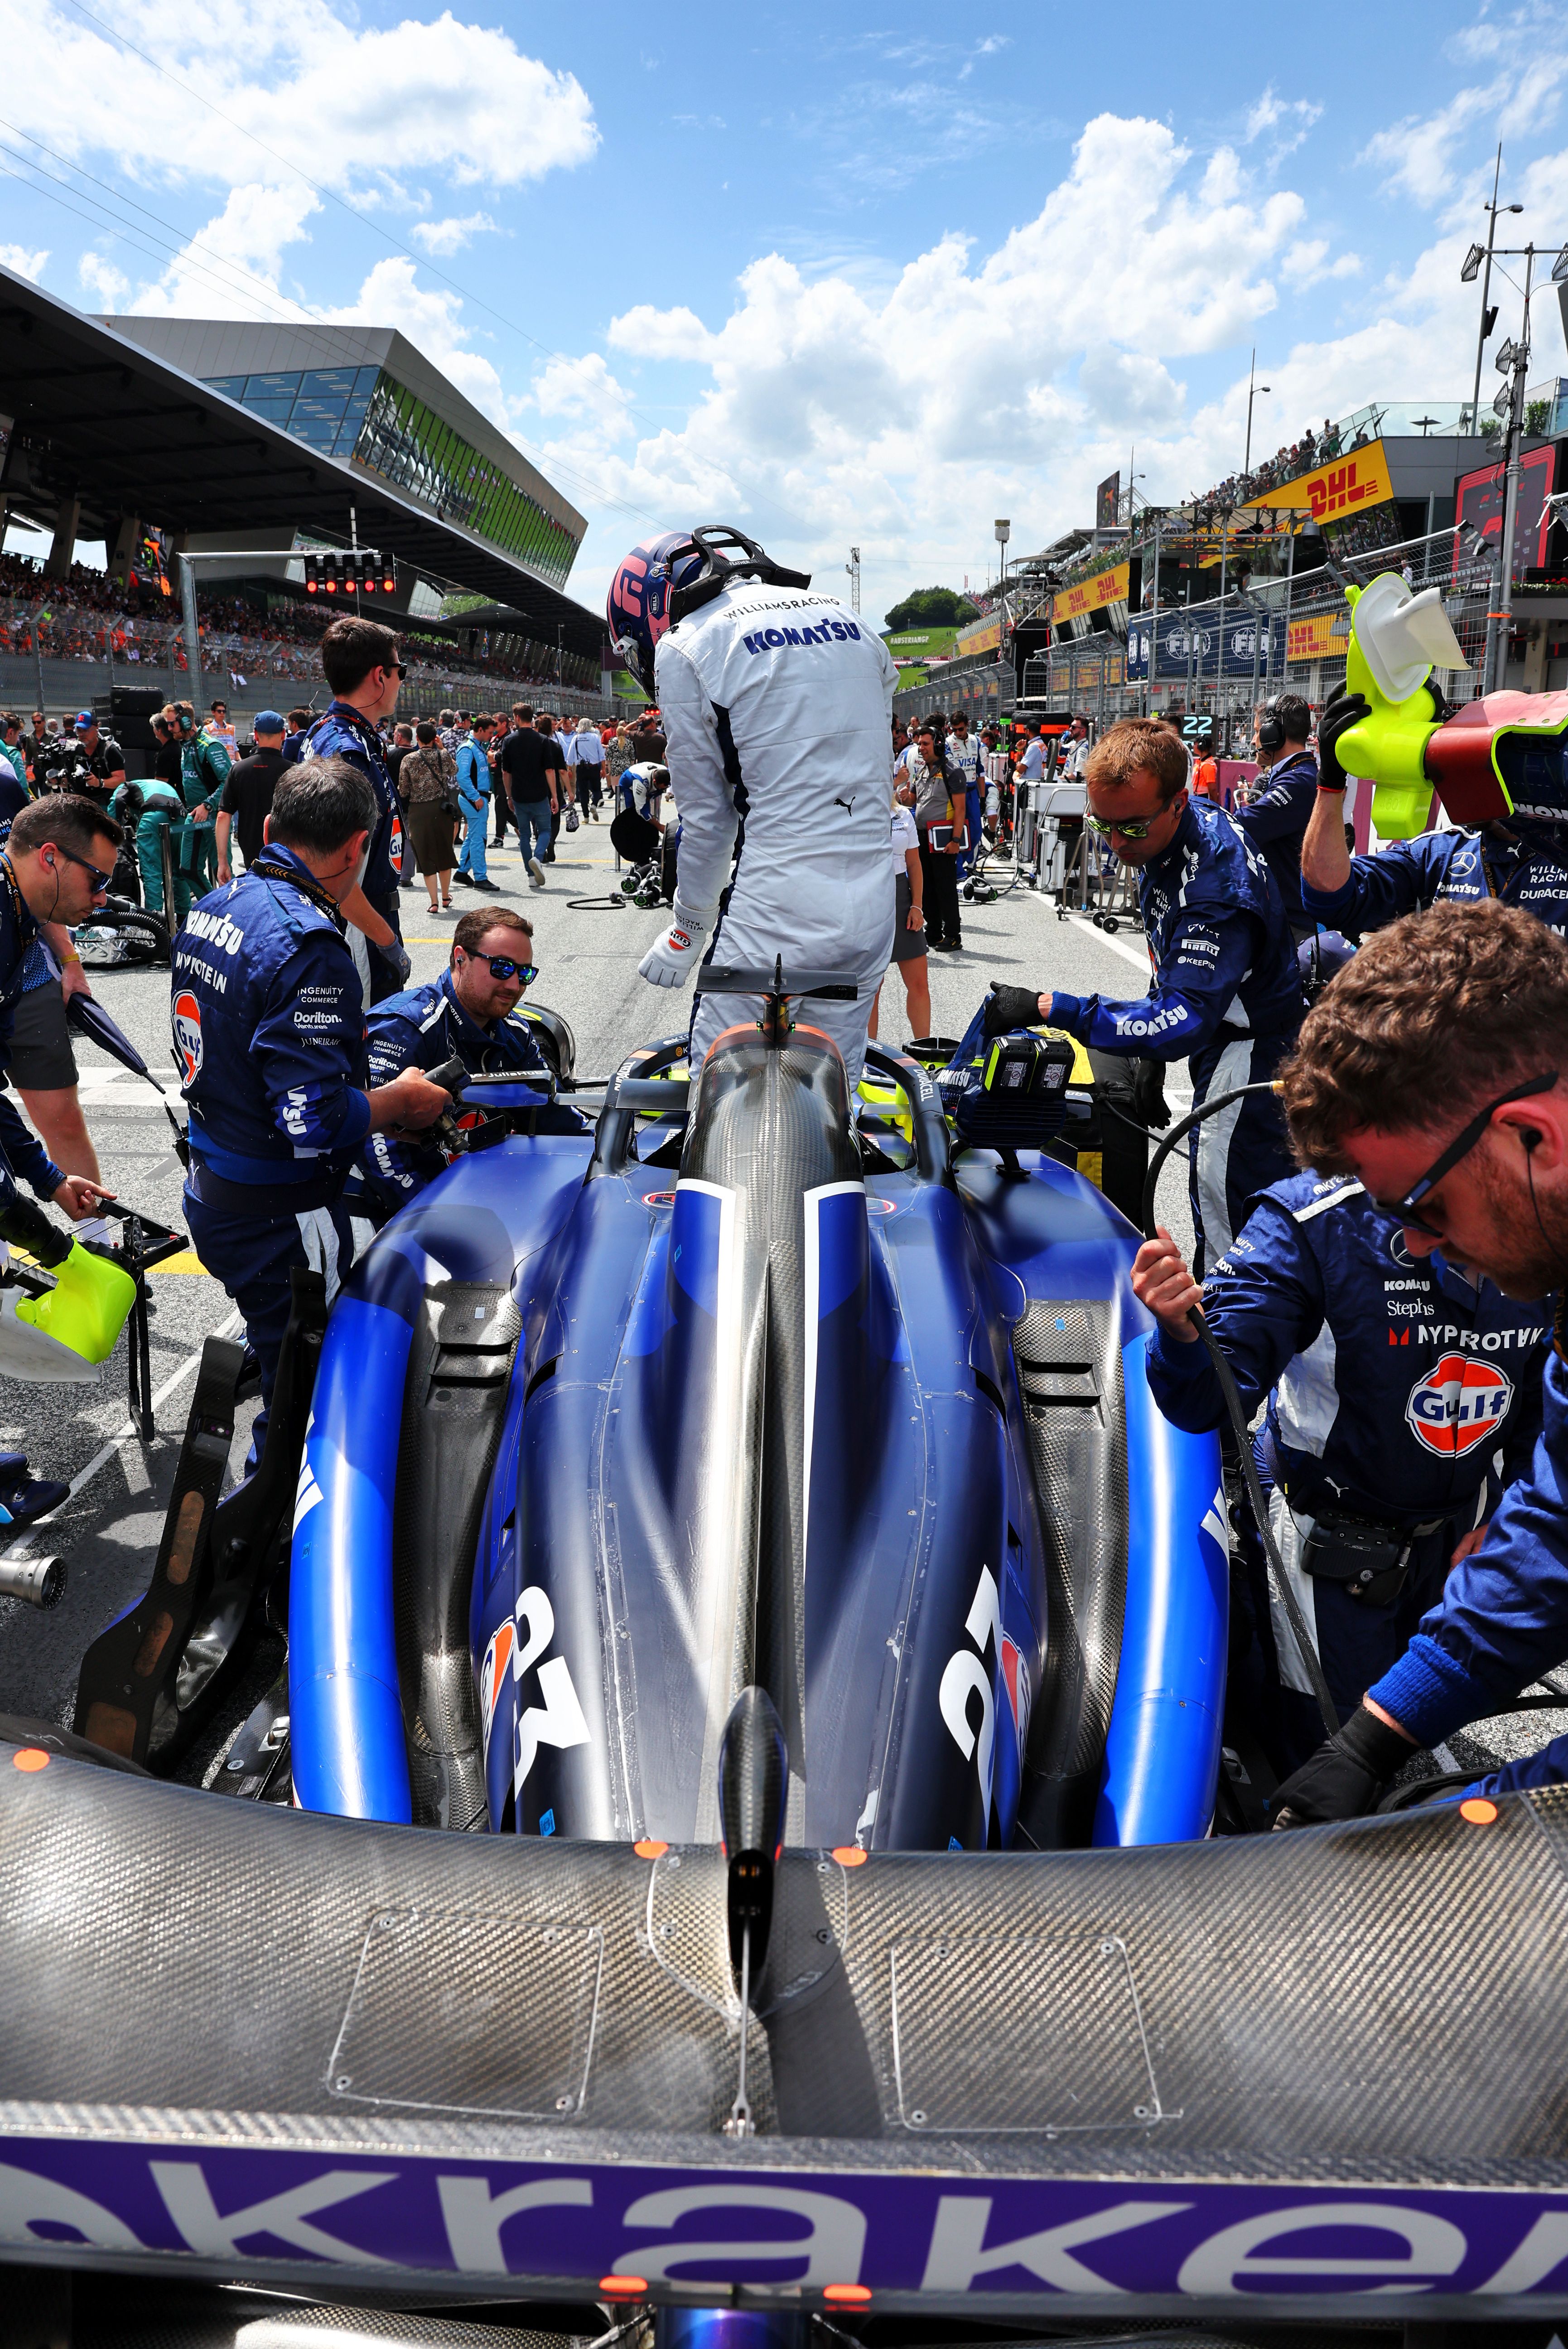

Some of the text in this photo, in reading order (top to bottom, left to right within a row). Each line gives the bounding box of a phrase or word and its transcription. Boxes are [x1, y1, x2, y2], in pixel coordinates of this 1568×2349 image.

[1307, 462, 1365, 518] DHL
[1097, 574, 1119, 602] DHL
[1068, 589, 1088, 613] DHL
[743, 618, 861, 656] KOMATSU
[890, 636, 929, 644] #AUSTRIANGP
[1235, 634, 1269, 652] FIA
[976, 721, 983, 729] 3
[1183, 716, 1212, 734] 22
[958, 757, 976, 767] VISA
[1281, 787, 1293, 801] kraken
[390, 839, 402, 855] Gu
[1530, 873, 1568, 883] RACIN
[670, 931, 691, 947] Gulf
[1181, 939, 1220, 957] PIRELLI
[1187, 957, 1215, 971] KEEPER
[297, 985, 344, 997] INGENUITY
[373, 1039, 407, 1053] INGENUITY
[373, 1046, 401, 1057] COMMERCE
[913, 1069, 934, 1102] DURACELL
[371, 1132, 414, 1188] KOMAU
[1412, 1390, 1507, 1422] Gulf
